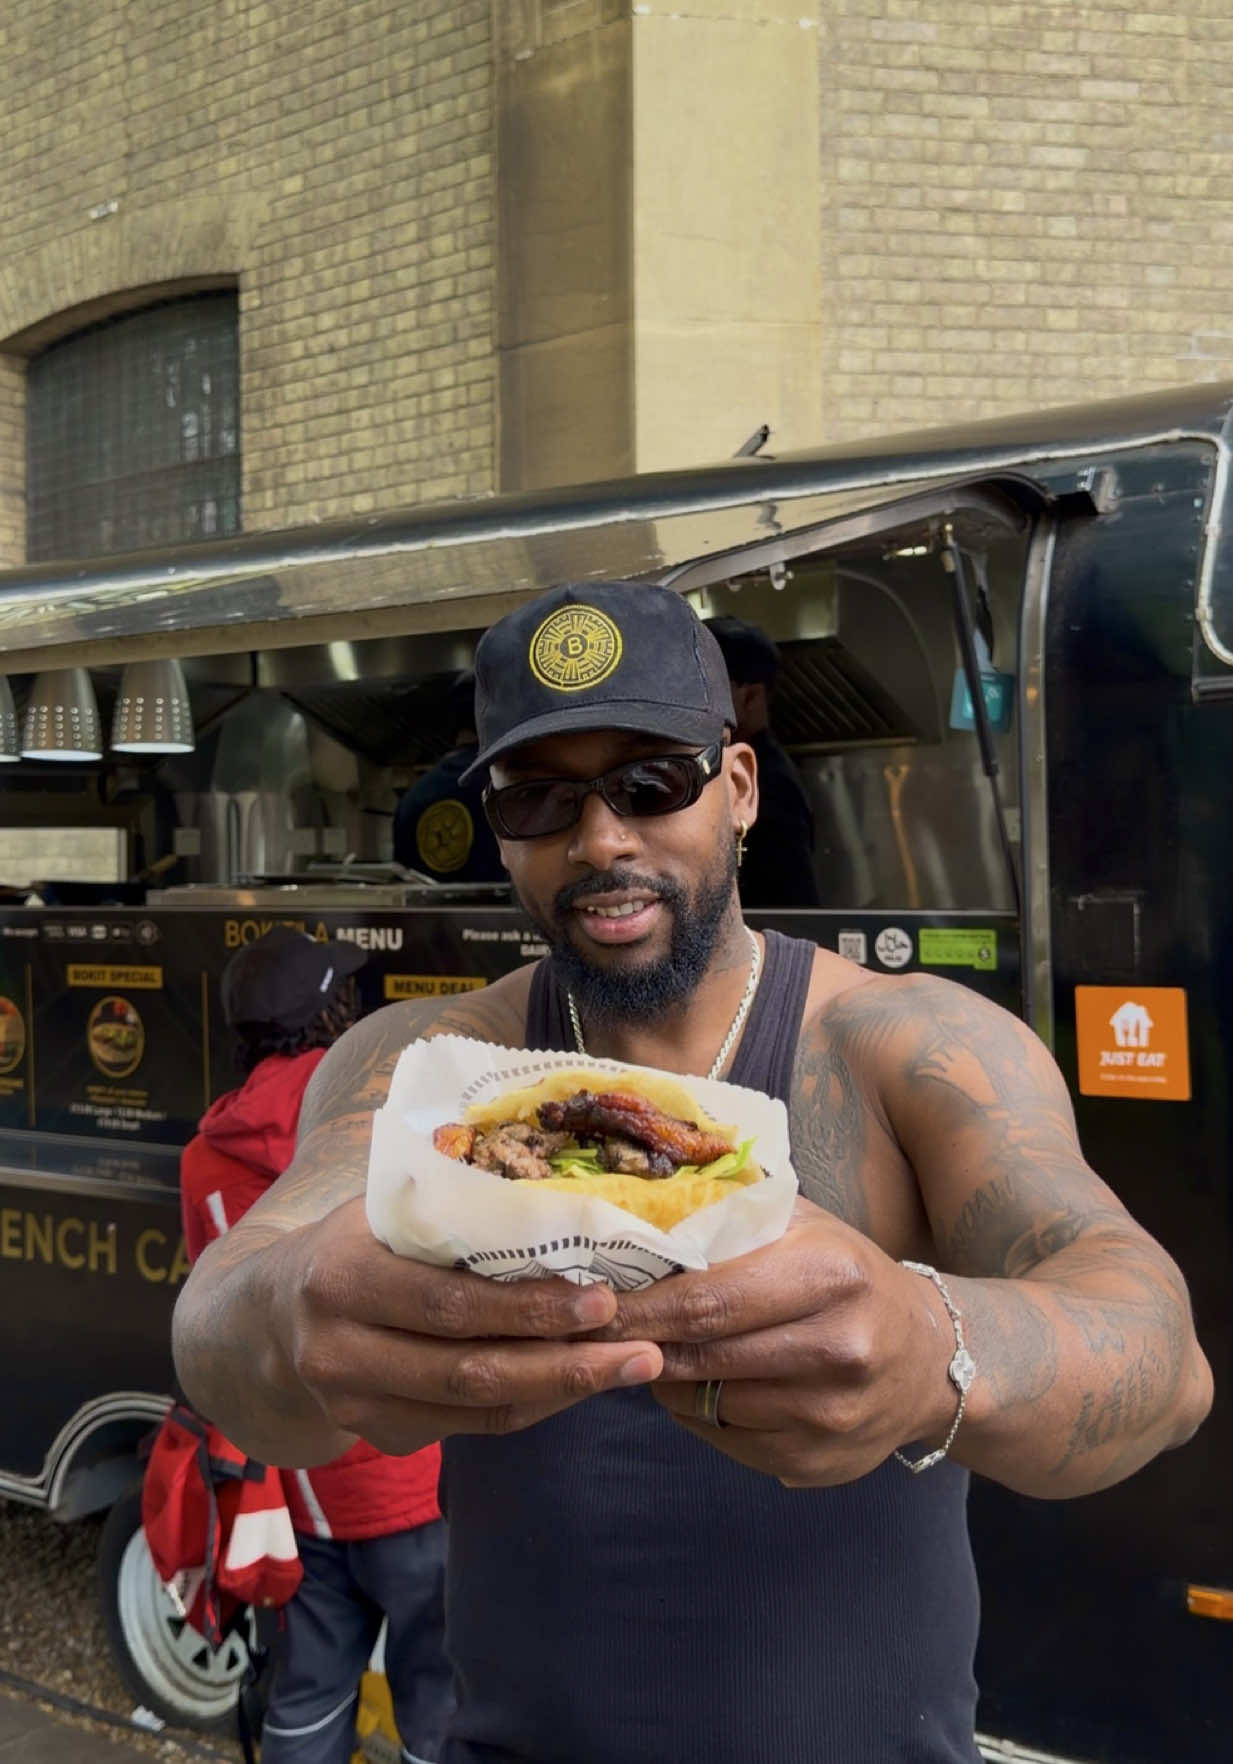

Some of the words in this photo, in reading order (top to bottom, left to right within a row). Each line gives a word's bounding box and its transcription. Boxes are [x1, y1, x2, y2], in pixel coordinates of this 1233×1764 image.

[567, 637, 583, 655] B
[336, 928, 403, 950] MENU
[462, 928, 499, 941] Please
[110, 970, 158, 984] SPECIAL
[394, 980, 434, 993] MENU
[1099, 1051, 1135, 1066] JUST
[1137, 1052, 1167, 1067] EAT
